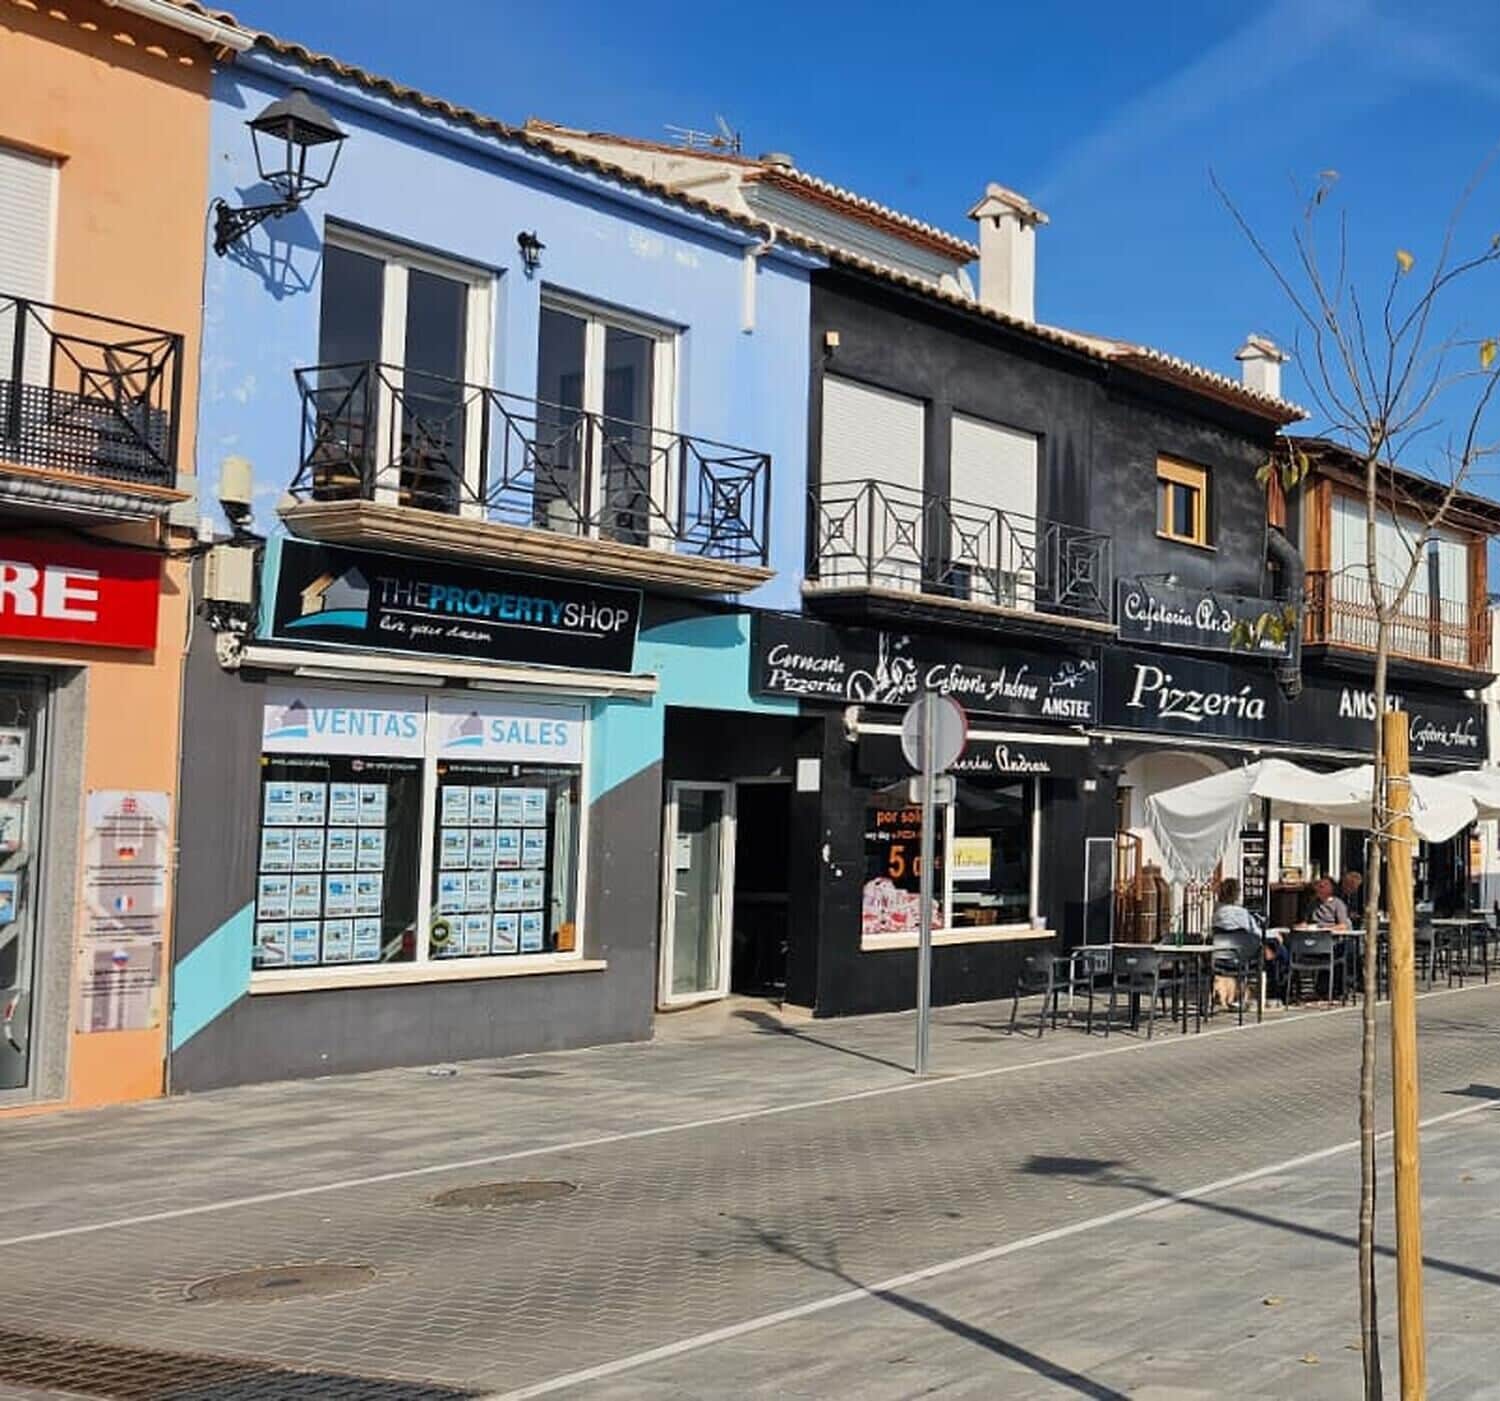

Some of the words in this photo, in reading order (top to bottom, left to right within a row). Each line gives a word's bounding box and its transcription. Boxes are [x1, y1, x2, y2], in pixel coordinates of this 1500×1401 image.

[1041, 697, 1092, 718] AMSTEL
[1126, 664, 1266, 722] Pizzería
[1338, 688, 1404, 721] AMSEL
[311, 708, 418, 739] VENTAS
[490, 718, 568, 747] SALES
[888, 845, 907, 877] 5
